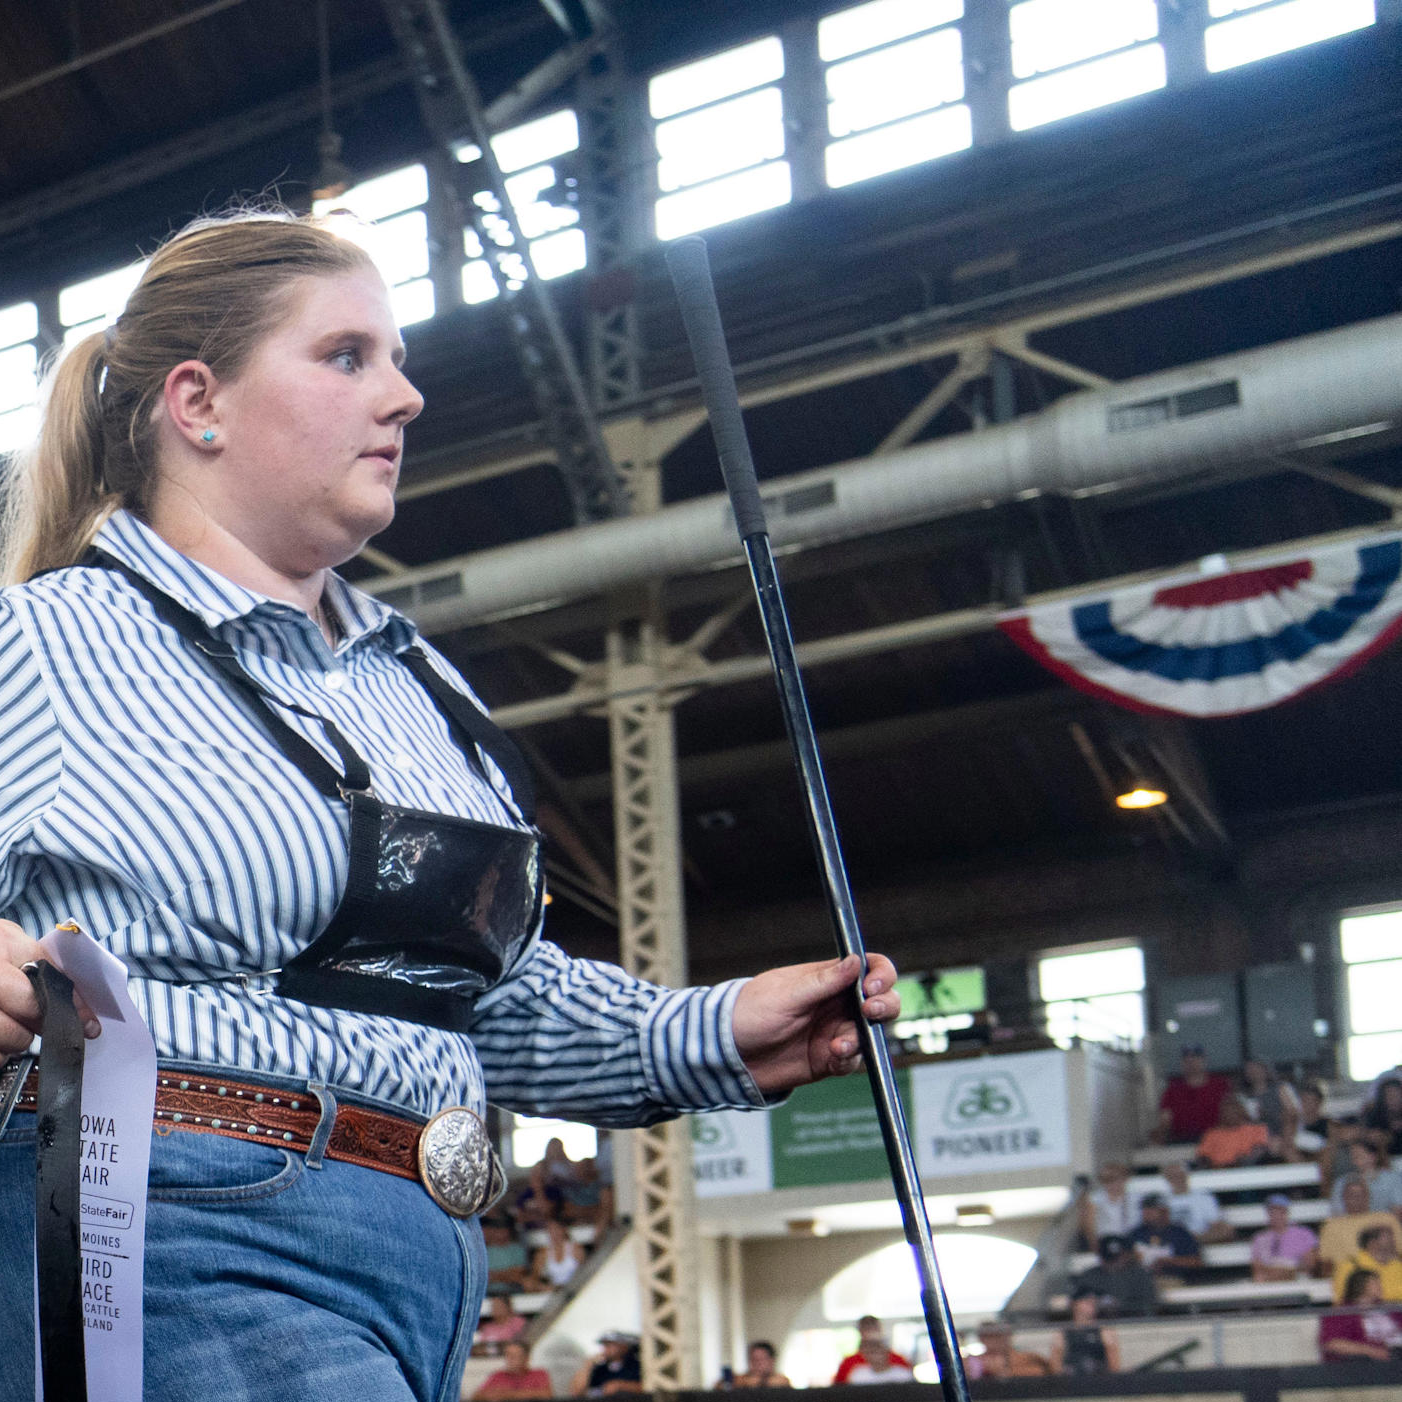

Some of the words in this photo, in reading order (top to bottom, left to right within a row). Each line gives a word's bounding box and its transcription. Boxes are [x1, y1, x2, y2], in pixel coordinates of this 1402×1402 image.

[80, 1114, 115, 1137] OWA
[80, 1139, 119, 1163] TATE
[933, 1127, 1042, 1159] PIONEER
[82, 1165, 109, 1187] AIR
[692, 1157, 747, 1181] NEER
[80, 1203, 128, 1220] StateFair
[82, 1232, 121, 1249] MOINES
[82, 1257, 112, 1279] IRD
[83, 1281, 113, 1303] ACE
[84, 1302, 120, 1319] CATTLE
[83, 1317, 113, 1332] LAND
